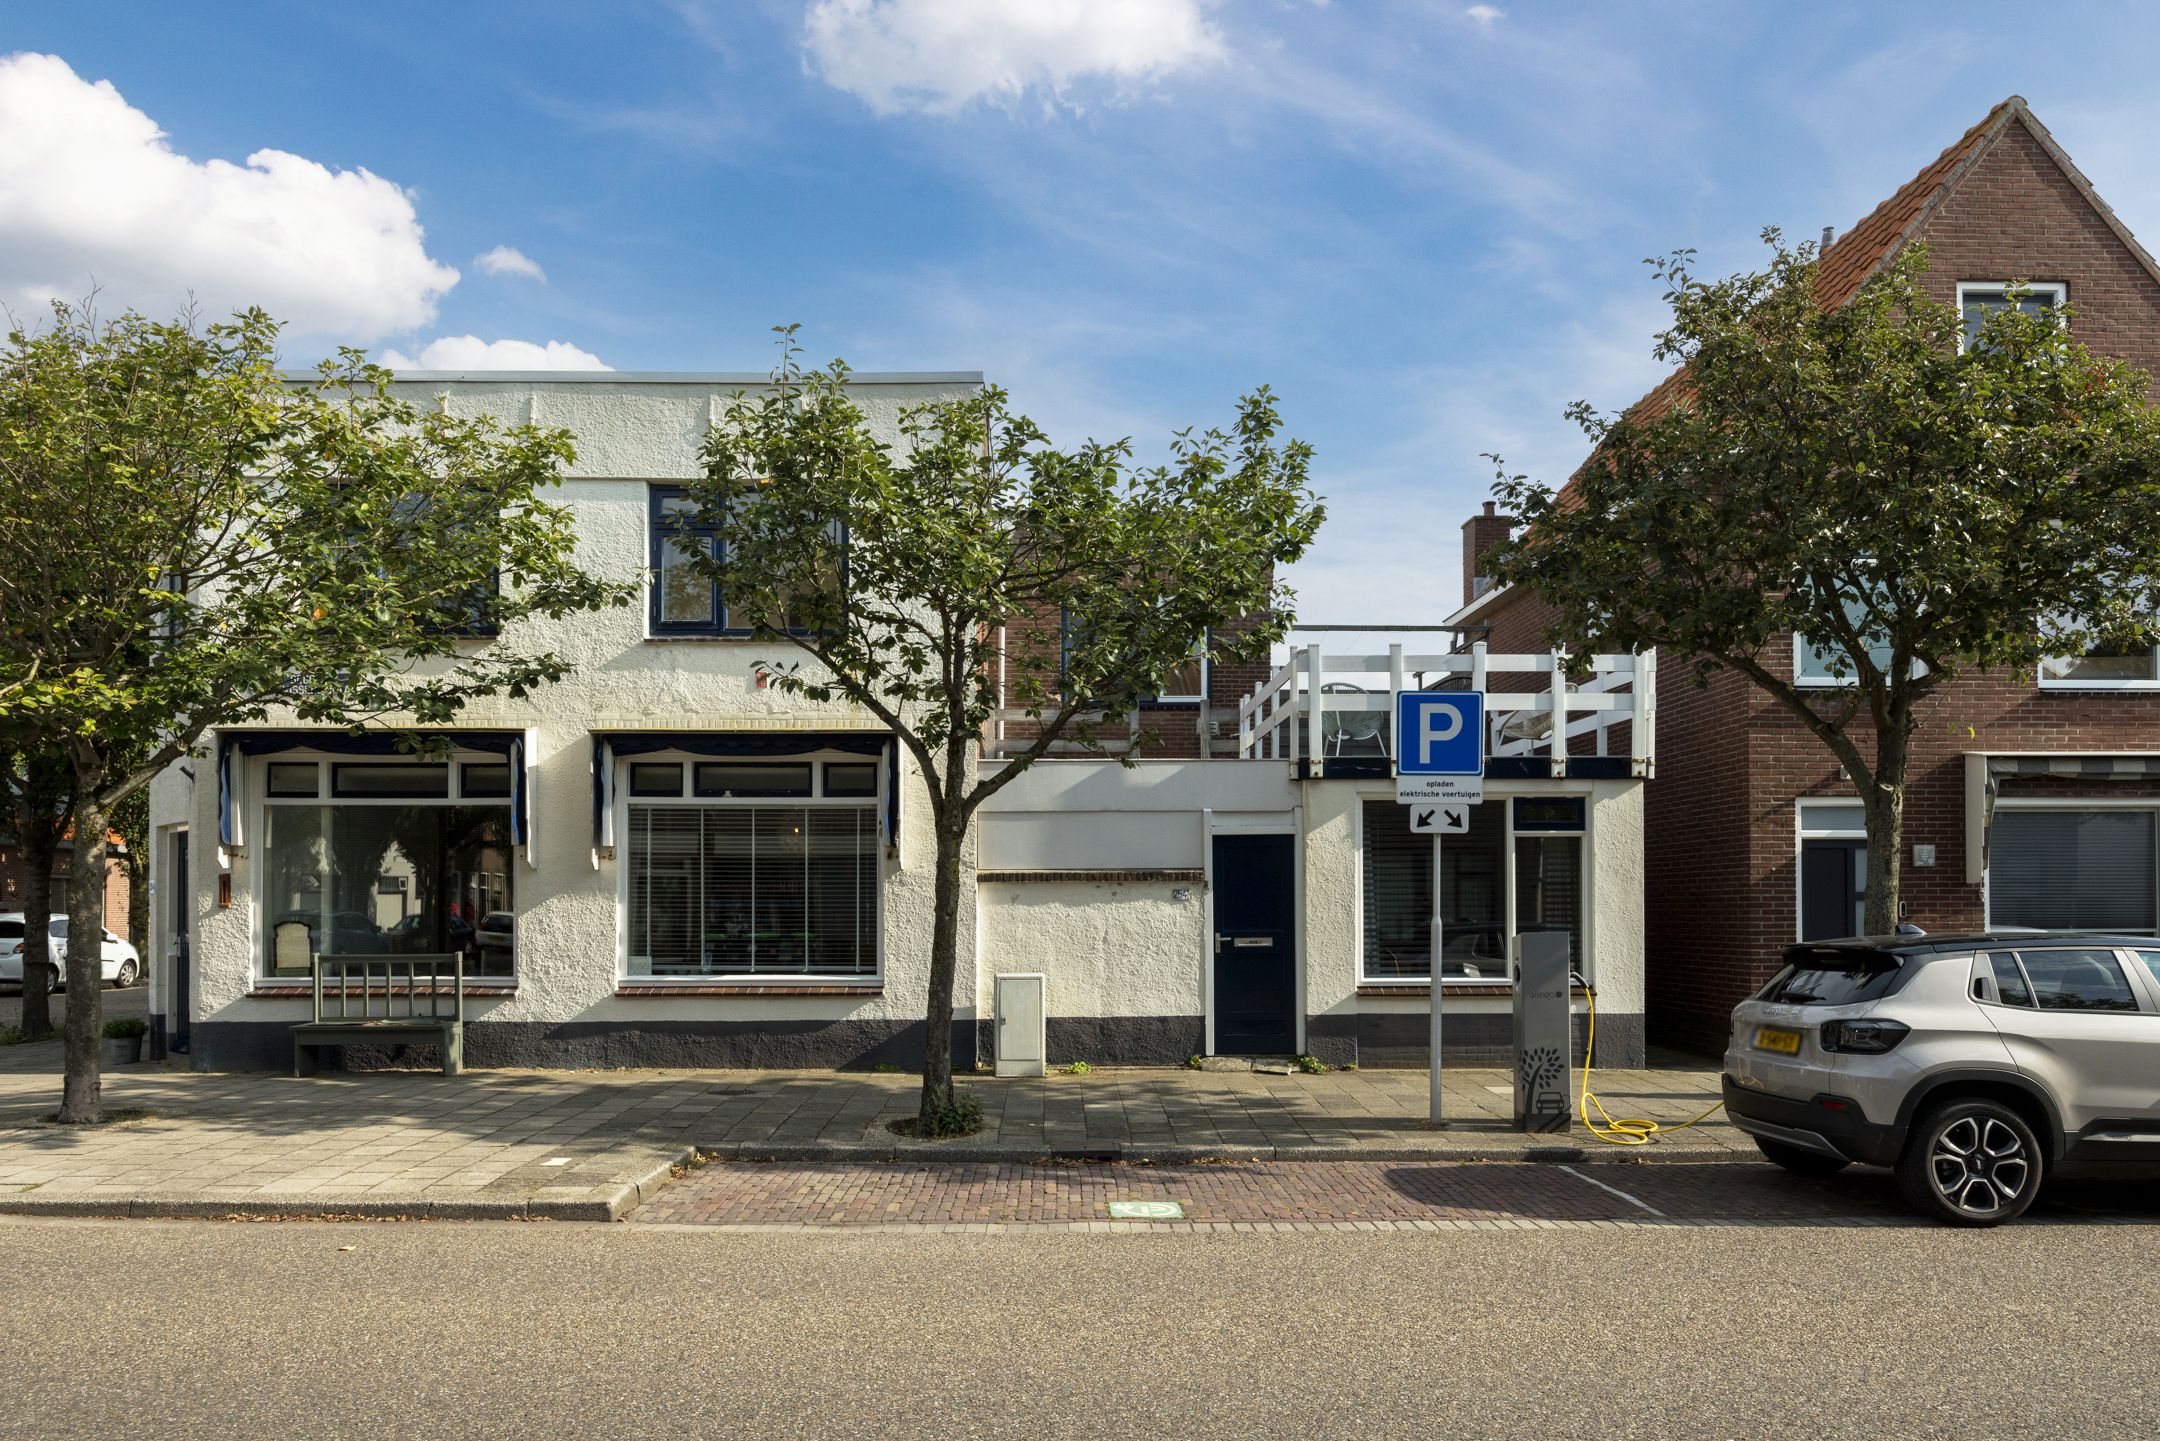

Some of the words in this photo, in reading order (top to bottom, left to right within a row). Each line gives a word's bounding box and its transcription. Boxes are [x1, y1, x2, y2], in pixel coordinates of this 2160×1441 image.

[1419, 703, 1463, 764] P
[1399, 790, 1440, 798] elektrische
[1441, 790, 1481, 799] voertuigen
